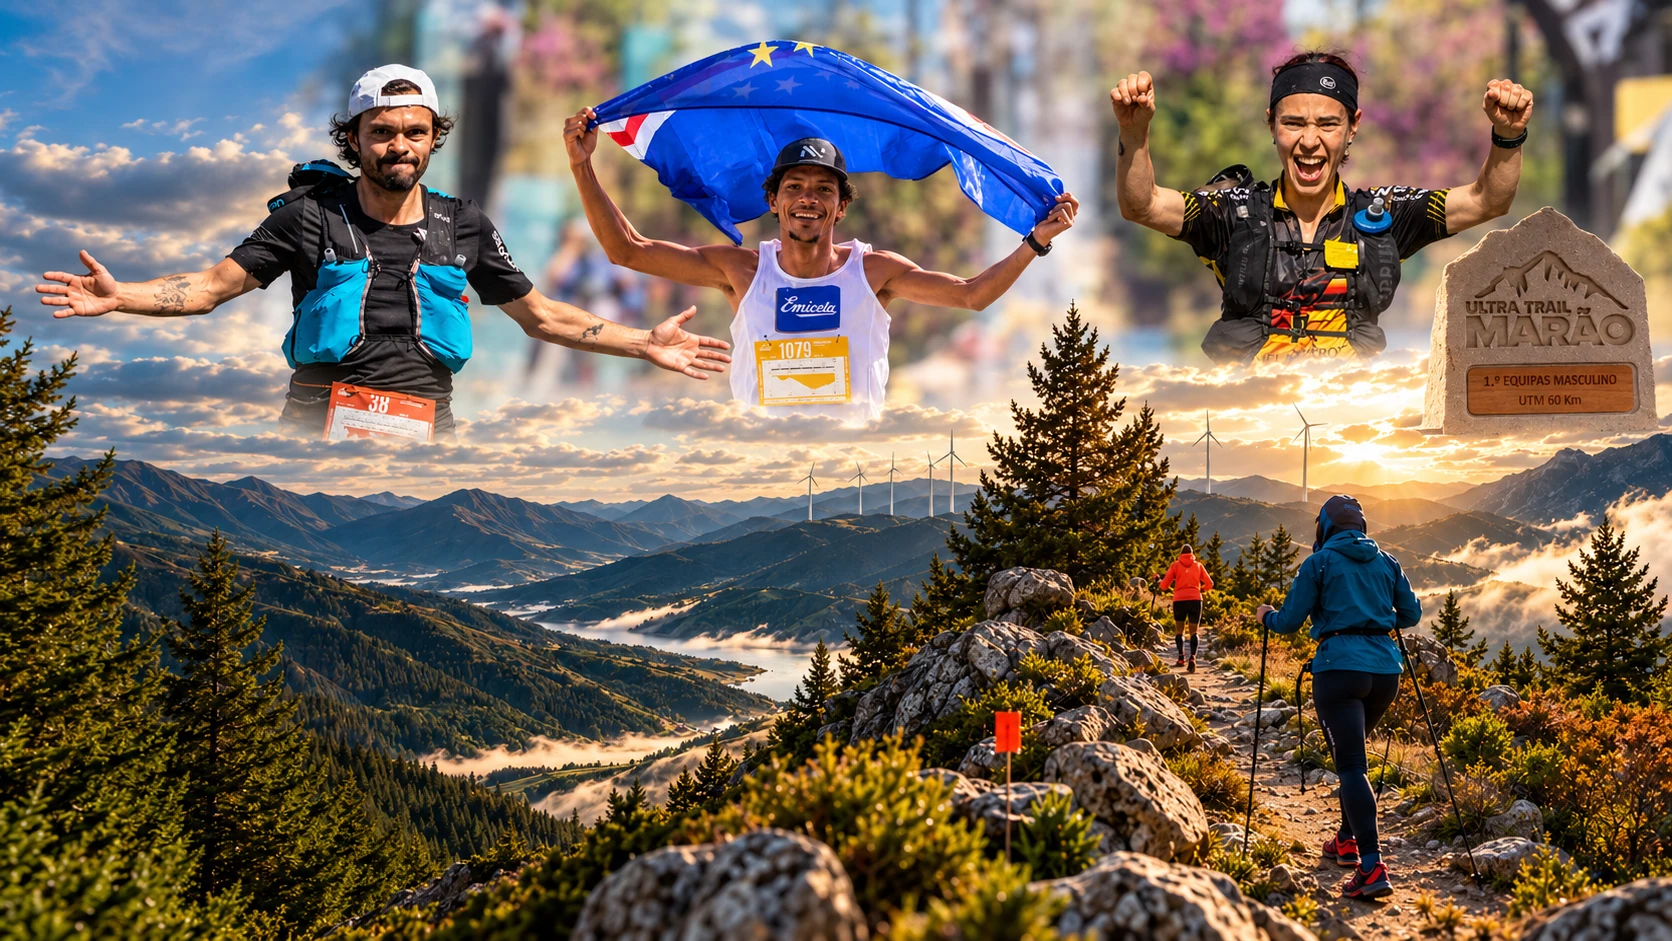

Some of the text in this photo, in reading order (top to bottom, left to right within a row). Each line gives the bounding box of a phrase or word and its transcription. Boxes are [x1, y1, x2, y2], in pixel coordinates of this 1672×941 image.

[780, 295, 837, 314] Emicela
[1465, 300, 1572, 315] ULTRA TRAIL
[1465, 306, 1636, 349] MARÃO
[778, 341, 812, 360] 1079
[1503, 375, 1551, 387] EQUIPAS
[1553, 374, 1617, 386] MASCULINO
[368, 394, 390, 414] 38
[1518, 394, 1582, 406] UTM 60 Km
